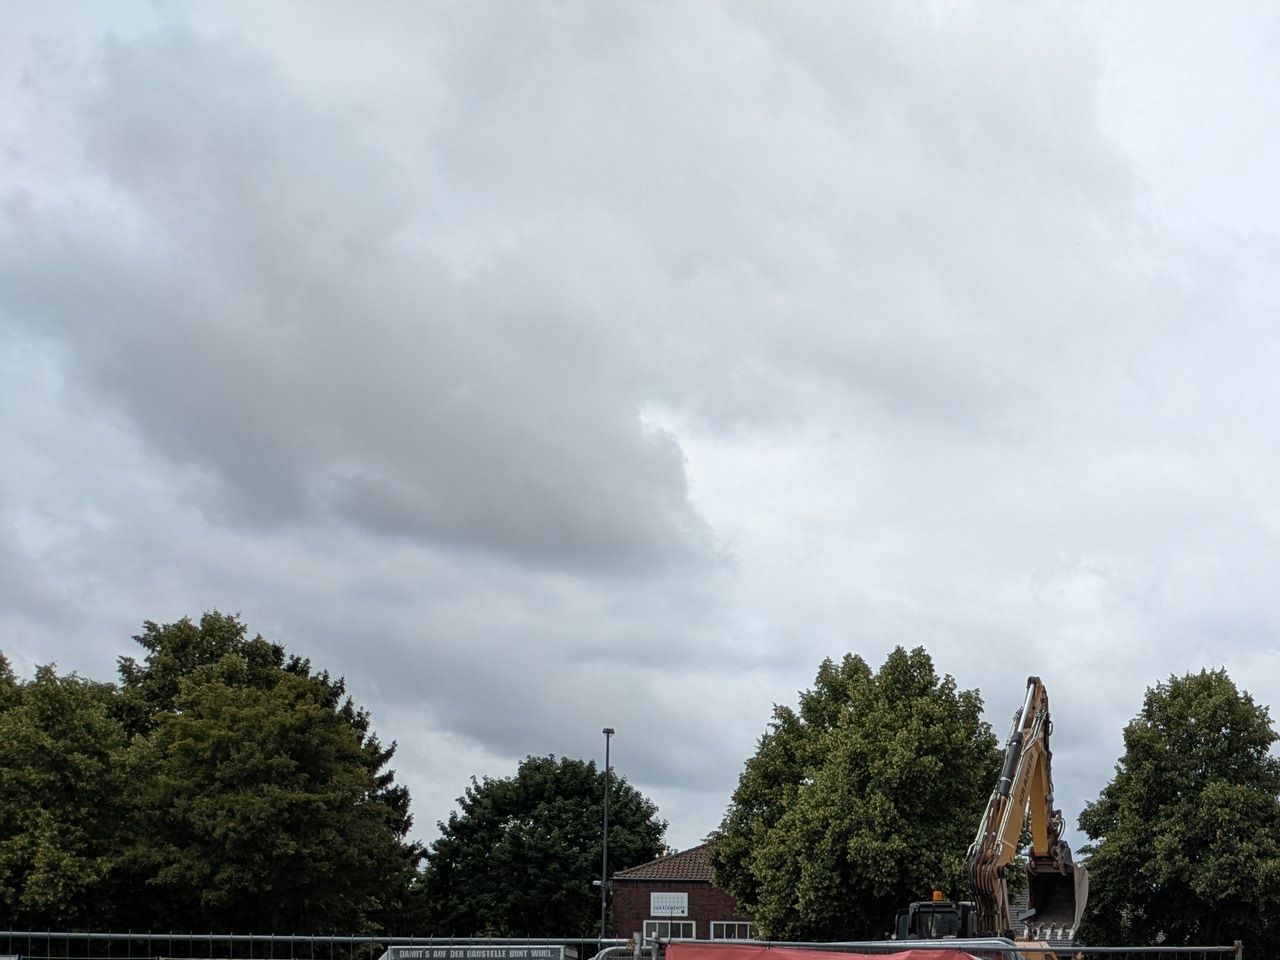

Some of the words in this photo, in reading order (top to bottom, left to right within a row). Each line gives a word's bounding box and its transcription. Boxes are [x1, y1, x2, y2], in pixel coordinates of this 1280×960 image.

[433, 949, 447, 958] AUF
[450, 949, 464, 958] DER
[466, 949, 507, 958] BAUSTELLE
[509, 949, 529, 958] BUNT
